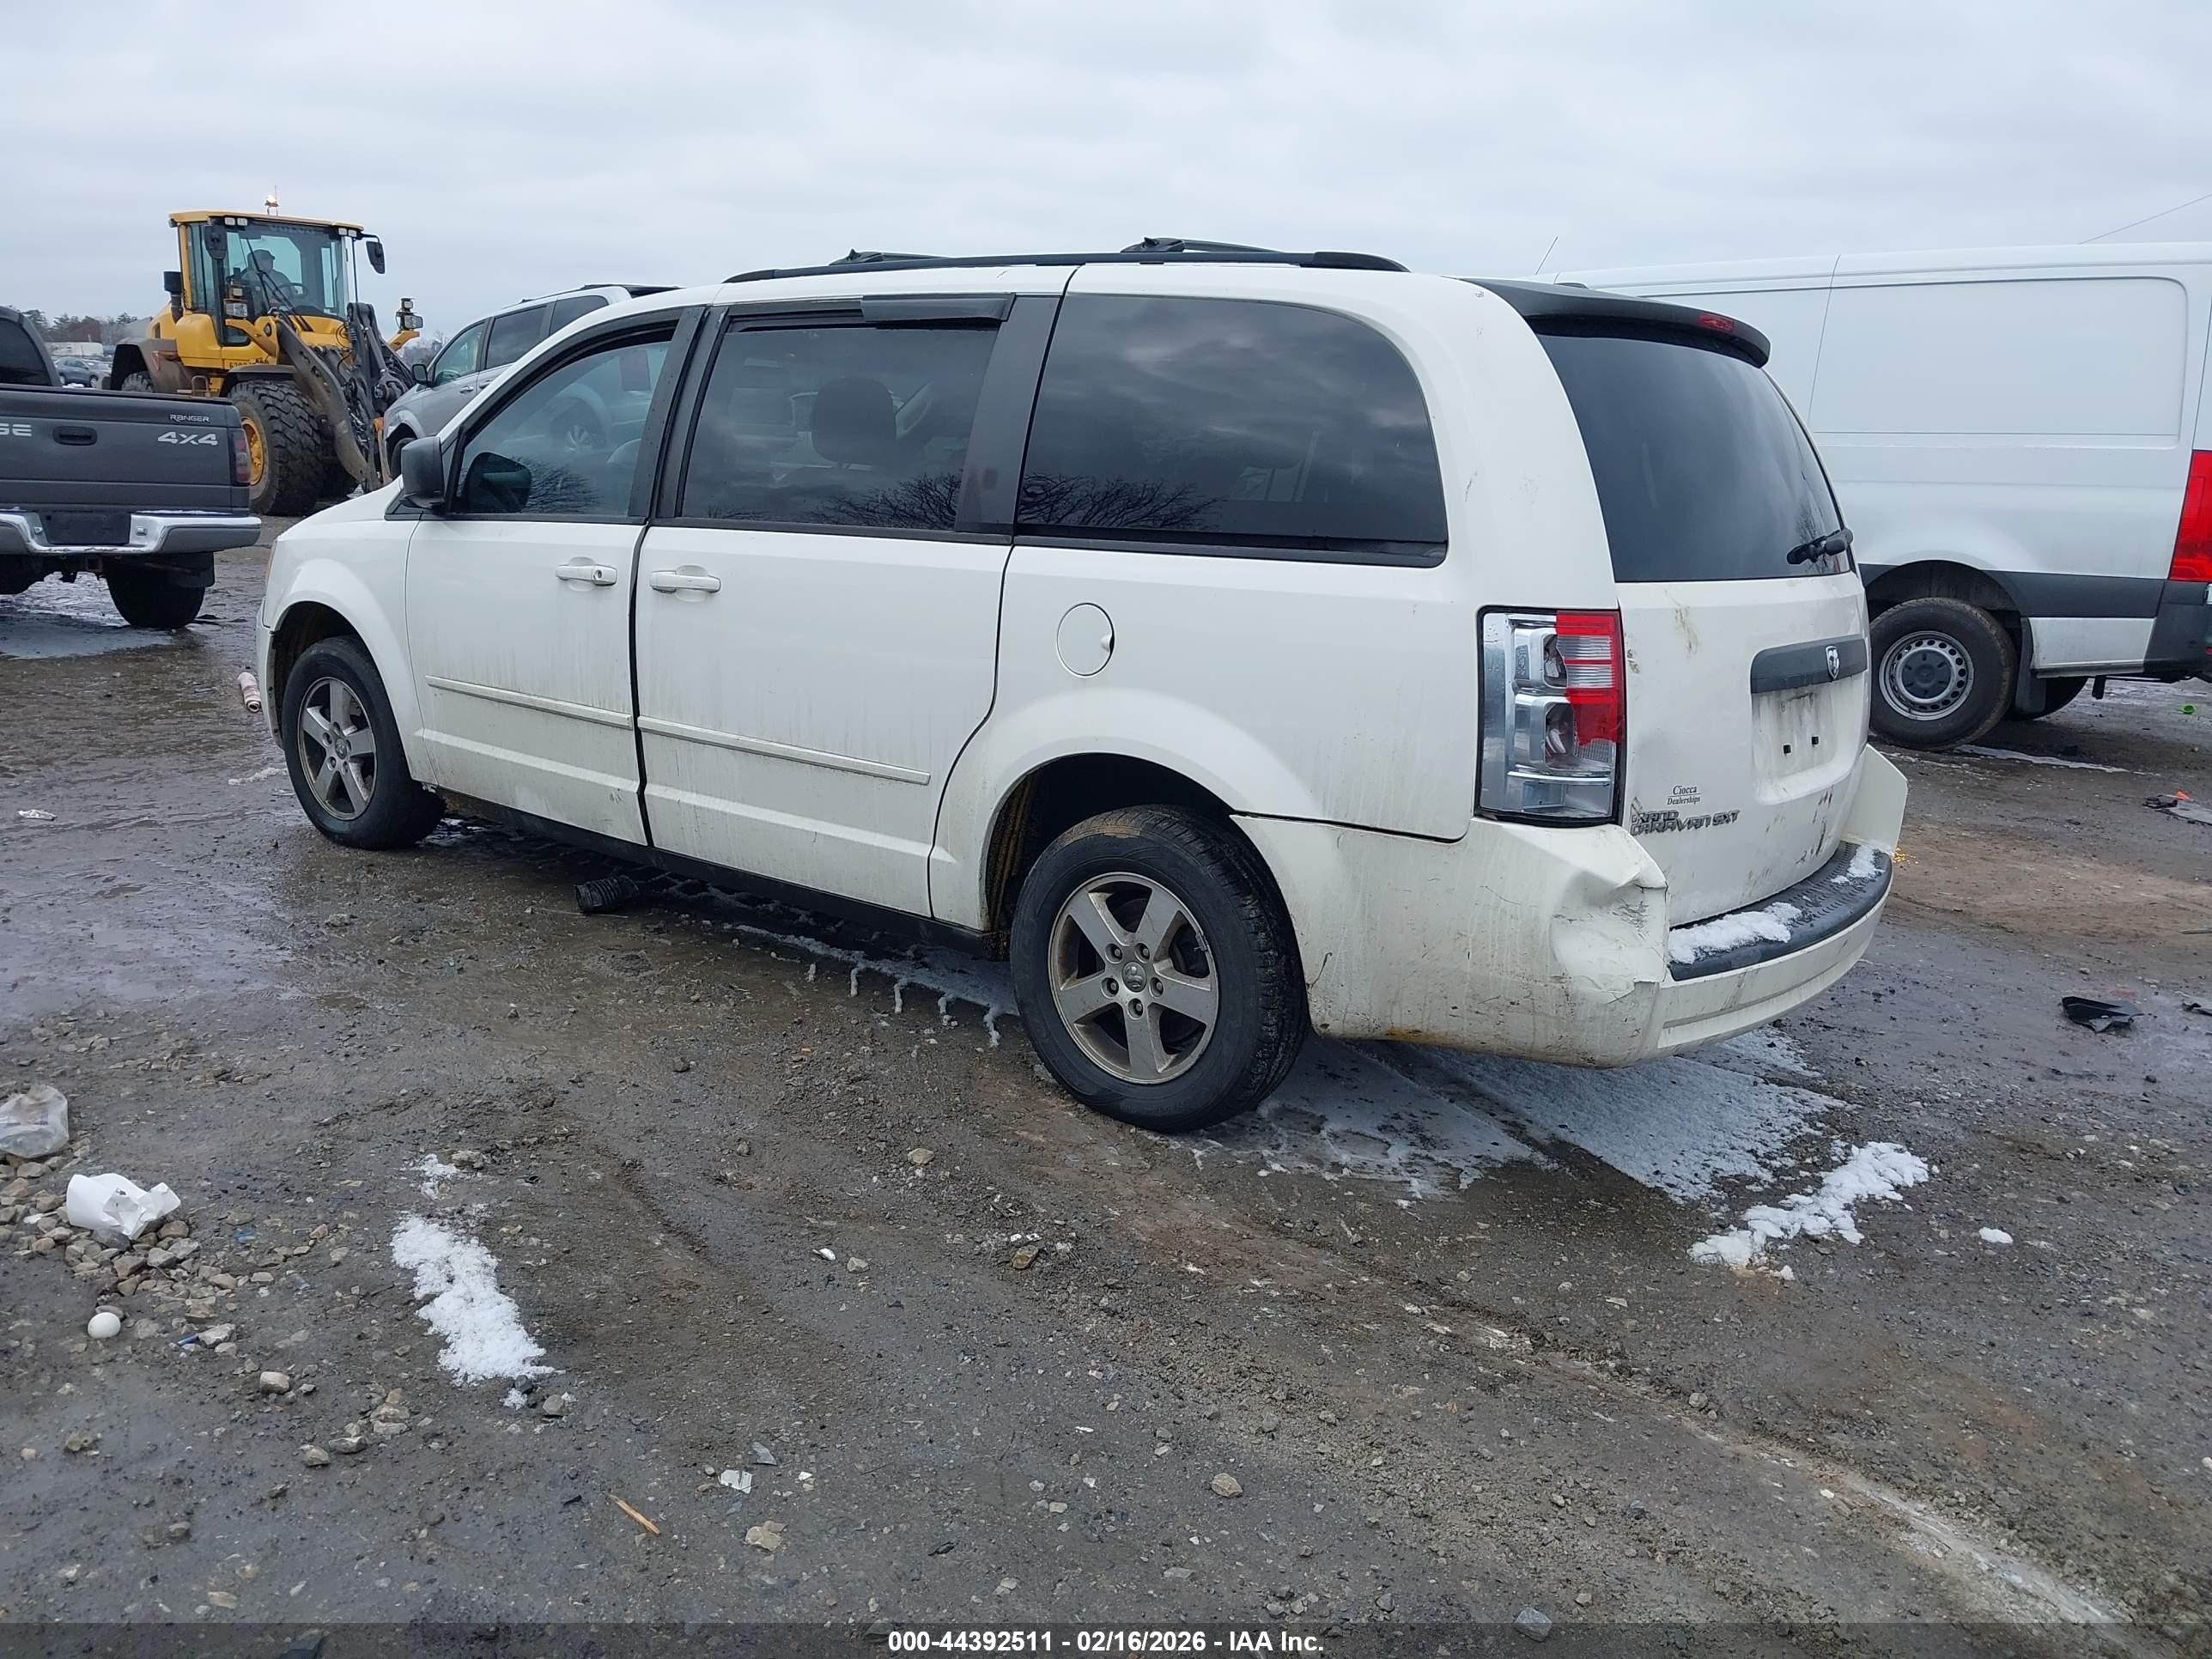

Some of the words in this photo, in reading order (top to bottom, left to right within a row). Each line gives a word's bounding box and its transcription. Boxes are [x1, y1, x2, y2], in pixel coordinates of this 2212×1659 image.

[169, 414, 210, 422] RANGER
[1673, 785, 1698, 795] Ciocca
[1667, 796, 1701, 805] Dealerships
[1630, 814, 1712, 836] CARAVAN
